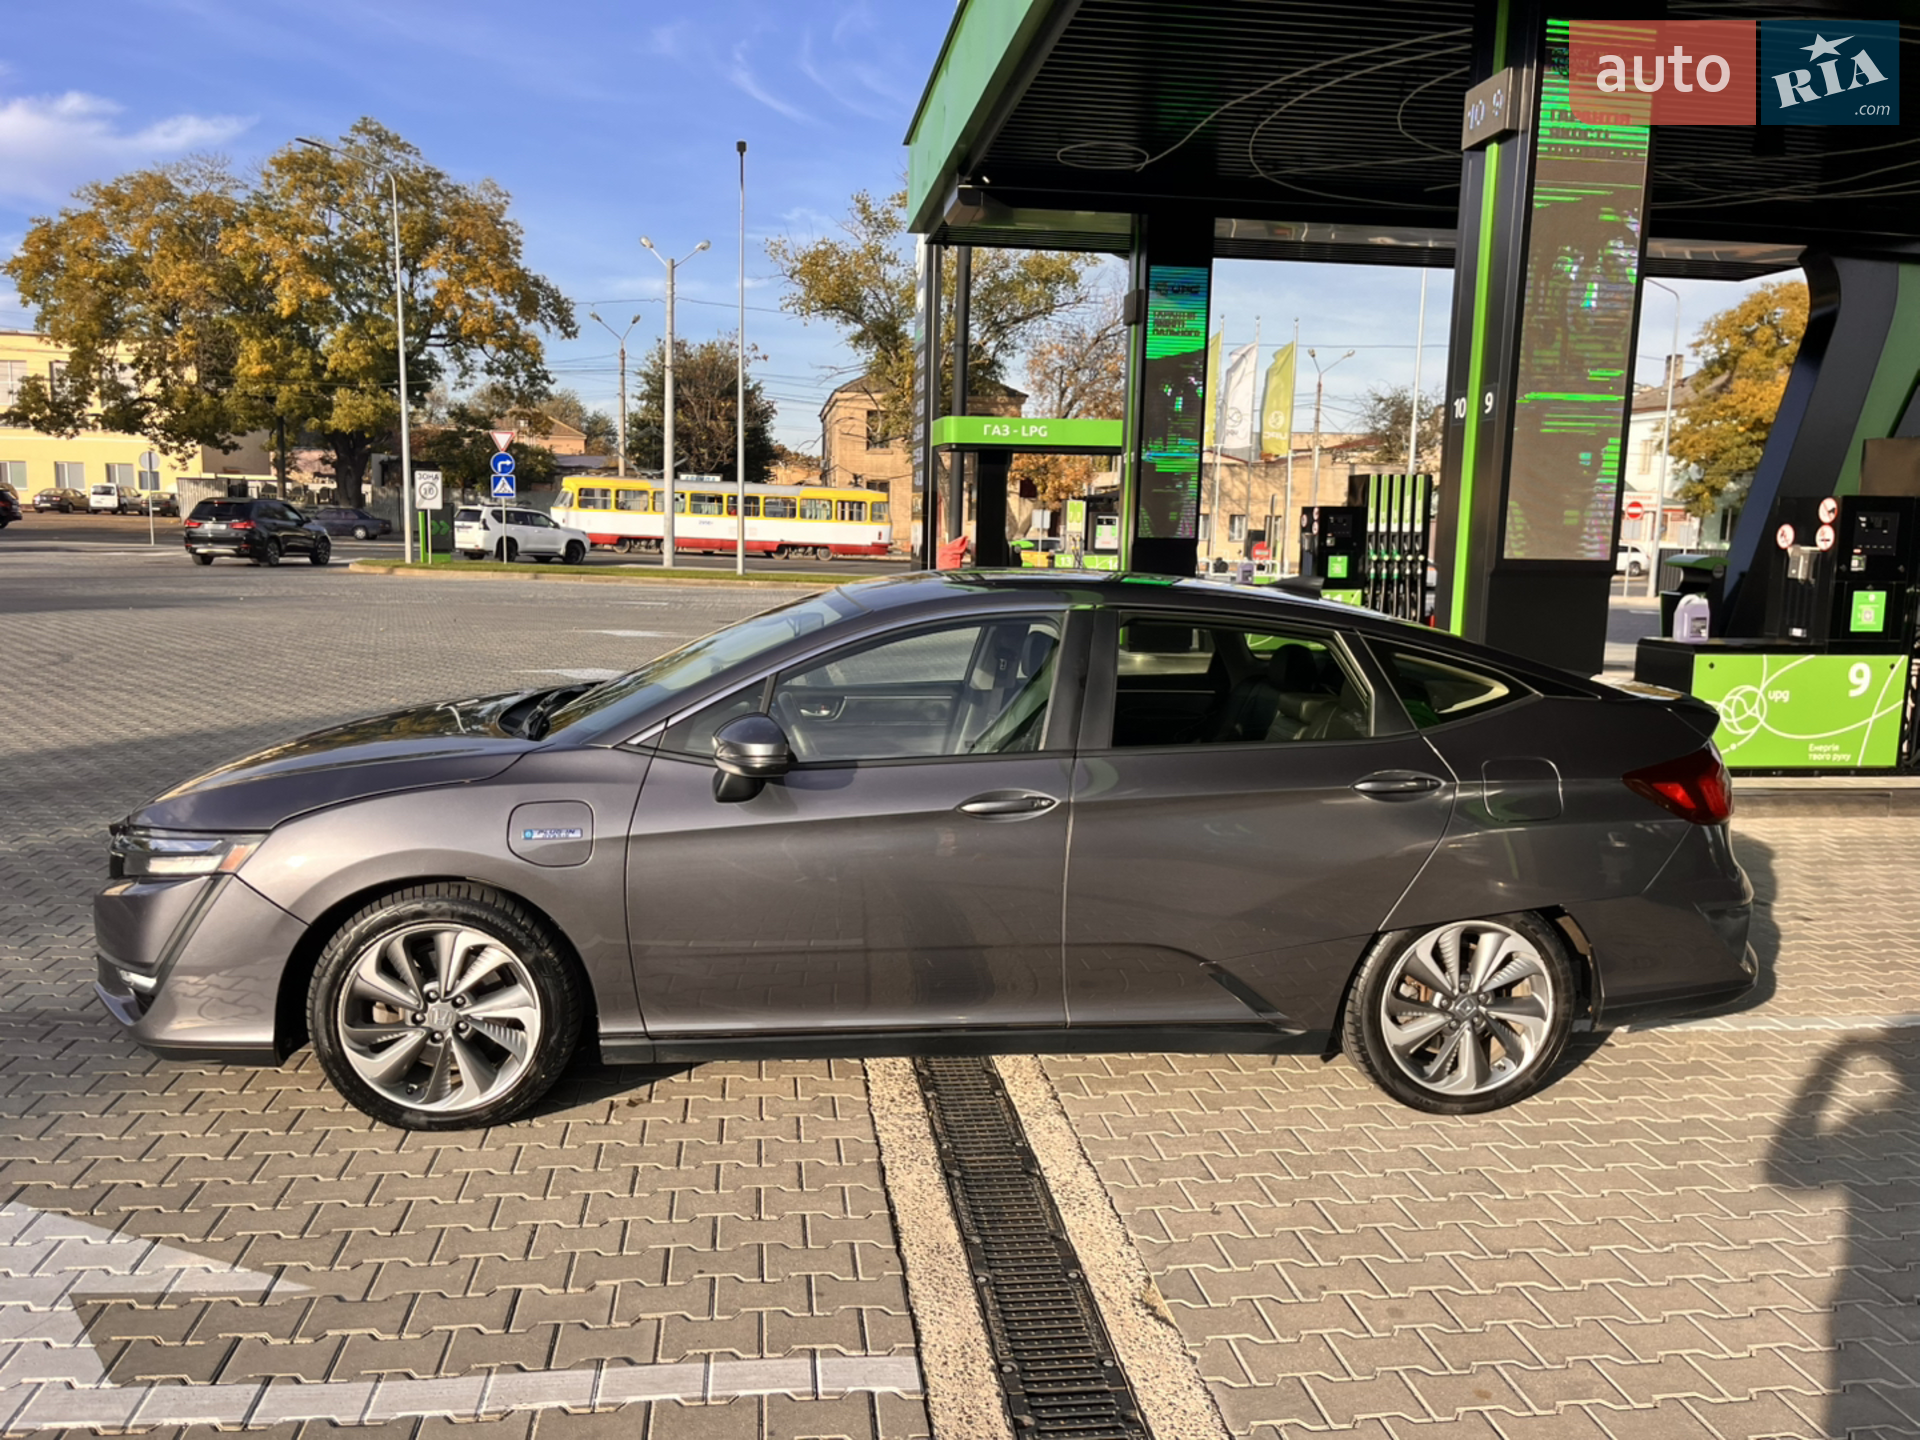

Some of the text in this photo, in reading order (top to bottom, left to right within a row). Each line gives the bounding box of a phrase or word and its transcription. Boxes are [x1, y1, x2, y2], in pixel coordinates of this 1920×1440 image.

[1467, 88, 1505, 130] 10 9
[1453, 397, 1467, 418] 10
[1484, 391, 1494, 414] 9
[983, 424, 1010, 437] ГАЗ
[1021, 425, 1048, 437] LPG
[1060, 557, 1071, 568] 13
[1848, 662, 1872, 698] 9
[1768, 690, 1790, 703] upg
[1808, 743, 1840, 753] Енергія
[1808, 753, 1851, 762] твого руху
